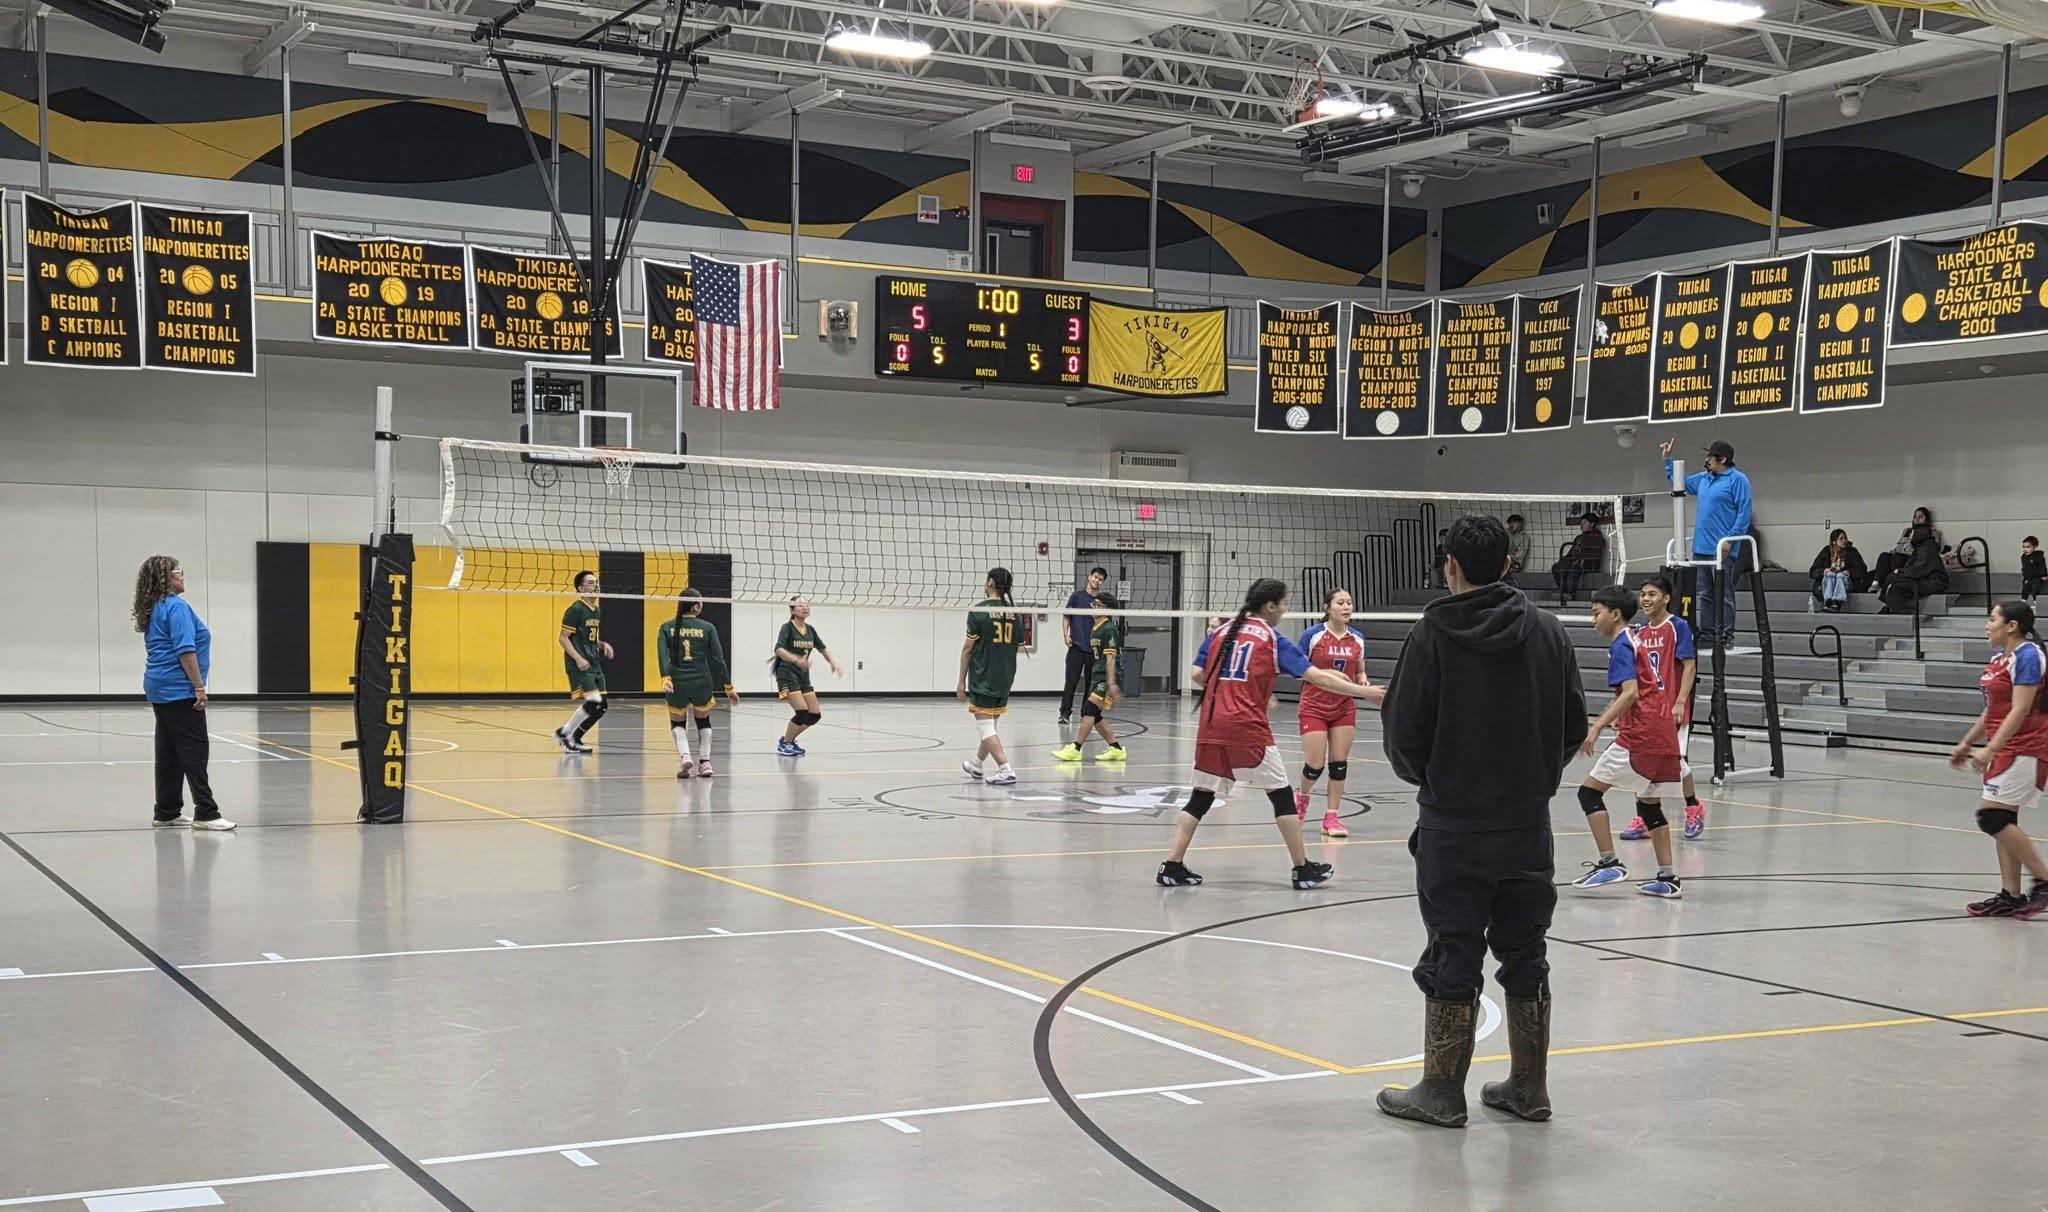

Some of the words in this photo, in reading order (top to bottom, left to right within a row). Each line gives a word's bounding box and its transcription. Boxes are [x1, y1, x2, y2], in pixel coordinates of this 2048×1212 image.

[1016, 166, 1033, 182] EXIT
[170, 217, 222, 236] TIKIGAQ
[28, 229, 132, 253] HARPOONERETTES
[144, 236, 248, 260] HARPOONERETTES
[360, 244, 422, 262] TIKIGAQ
[1937, 243, 2035, 271] HARPOONERS
[41, 262, 57, 278] 20
[108, 267, 123, 282] 04
[317, 256, 461, 280] HARPOONERETTES
[1832, 256, 1870, 275] TIKIGAQ
[1949, 265, 1993, 287] STATE
[2002, 261, 2022, 279] 2A
[160, 268, 175, 284] 20
[221, 274, 236, 289] 05
[477, 267, 591, 293] HARPOONERE
[1752, 268, 1787, 284] TIKIGAQ
[348, 283, 369, 298] 20
[418, 287, 434, 301] 19
[891, 281, 926, 297] HOME
[1679, 279, 1710, 295] TIKIGAQ
[1818, 277, 1880, 299] HARPOONERS
[1935, 280, 2031, 305] BASKETBALL
[51, 294, 99, 312] REGION
[507, 295, 526, 310] 20
[573, 300, 588, 314] 18
[978, 289, 1019, 313] 1:00
[1045, 294, 1082, 310] GUEST
[1741, 288, 1792, 307] HARPOONERS
[168, 300, 212, 318] REGION
[320, 302, 336, 318] 2A
[348, 305, 386, 322] STATE
[397, 308, 461, 326] CHAMPIONS
[676, 307, 693, 323] 20
[1665, 298, 1718, 317] HARPOONERS
[1939, 296, 2022, 321] CHAMPIONS
[481, 314, 495, 329] 2A
[507, 317, 543, 334] STATE
[912, 305, 925, 330] 5
[1448, 318, 1504, 332] HARPOONERS
[1524, 317, 1571, 335] VOLLEYBALL
[1736, 321, 1747, 336] 20
[1778, 317, 1790, 331] 02
[1818, 314, 1830, 329] 20
[1864, 307, 1875, 323] 01
[158, 321, 240, 342] BASKETBALL
[336, 320, 448, 341] BASKETBALL
[652, 325, 665, 340] 2A
[969, 324, 990, 333] PERIOD
[999, 323, 1005, 337] 1
[1068, 318, 1079, 341] 3
[1268, 322, 1329, 335] HARPOONERS
[1360, 323, 1422, 338] HARPOONERS
[1610, 327, 1650, 345] CHAMPIONS
[1663, 331, 1673, 345] 20
[1705, 326, 1716, 340] 03
[1960, 318, 1996, 336] 2001
[496, 331, 590, 351] BASKETBAL
[889, 333, 909, 343] FOULS
[966, 339, 990, 349] PLAYER
[991, 340, 1007, 350] FOUL
[1261, 334, 1289, 348] REGION
[1297, 337, 1300, 348] 1
[1309, 336, 1336, 349] NORTH
[1352, 338, 1386, 352] REGION
[1390, 340, 1393, 350] 1
[1399, 337, 1430, 351] NORTH
[1440, 334, 1472, 347] REGION
[1475, 335, 1478, 344] 1
[1483, 331, 1511, 345] NORTH
[1530, 338, 1561, 353] DISTRICT
[165, 345, 235, 364] CHAMPIONS
[896, 344, 907, 362] 0
[932, 347, 943, 364] 5
[1062, 346, 1080, 355] FOULS
[1272, 349, 1299, 362] MIXED
[1309, 350, 1325, 362] SIX
[1451, 348, 1477, 361] MIXED
[1485, 347, 1499, 360] SIX
[1737, 347, 1767, 363] REGION
[1776, 346, 1783, 360] II
[1820, 340, 1852, 358] REGION
[1862, 337, 1869, 352] II
[888, 363, 909, 371] SCORE
[1030, 353, 1040, 371] 5
[1068, 356, 1078, 373] 0
[1363, 353, 1392, 366] MIXED
[1402, 352, 1417, 365] SIX
[1526, 357, 1564, 372] CHAMPIONS
[1667, 356, 1696, 372] REGION
[975, 368, 997, 377] MATCH
[1269, 362, 1328, 376] VOLLEYBALL
[1359, 367, 1420, 380] VOLLEYBALL
[1446, 362, 1500, 376] VOLLEYBALL
[1732, 368, 1784, 384] BASKETBALL
[1814, 361, 1872, 380] BASKETBALL
[1061, 374, 1080, 383] SCORE
[1113, 371, 1198, 391] HARPOONERETTES
[1272, 376, 1324, 390] CHAMPIONS
[1361, 381, 1416, 394] CHAMPIONS
[1449, 377, 1498, 391] CHAMPIONS
[1661, 376, 1711, 393] BASKETBALL
[1273, 391, 1322, 404] 2005-2006
[1448, 391, 1497, 405] 2001-2002
[1734, 388, 1781, 405] CHAMPIONS
[1818, 383, 1868, 401] CHAMPIONS
[1360, 395, 1416, 408] 2002-2003
[1664, 397, 1708, 413] CHAMPIONS
[670, 628, 704, 638] TAPPERS
[992, 622, 1014, 645] 30
[682, 639, 693, 662] 1
[384, 575, 407, 790] TIKIGAQ
